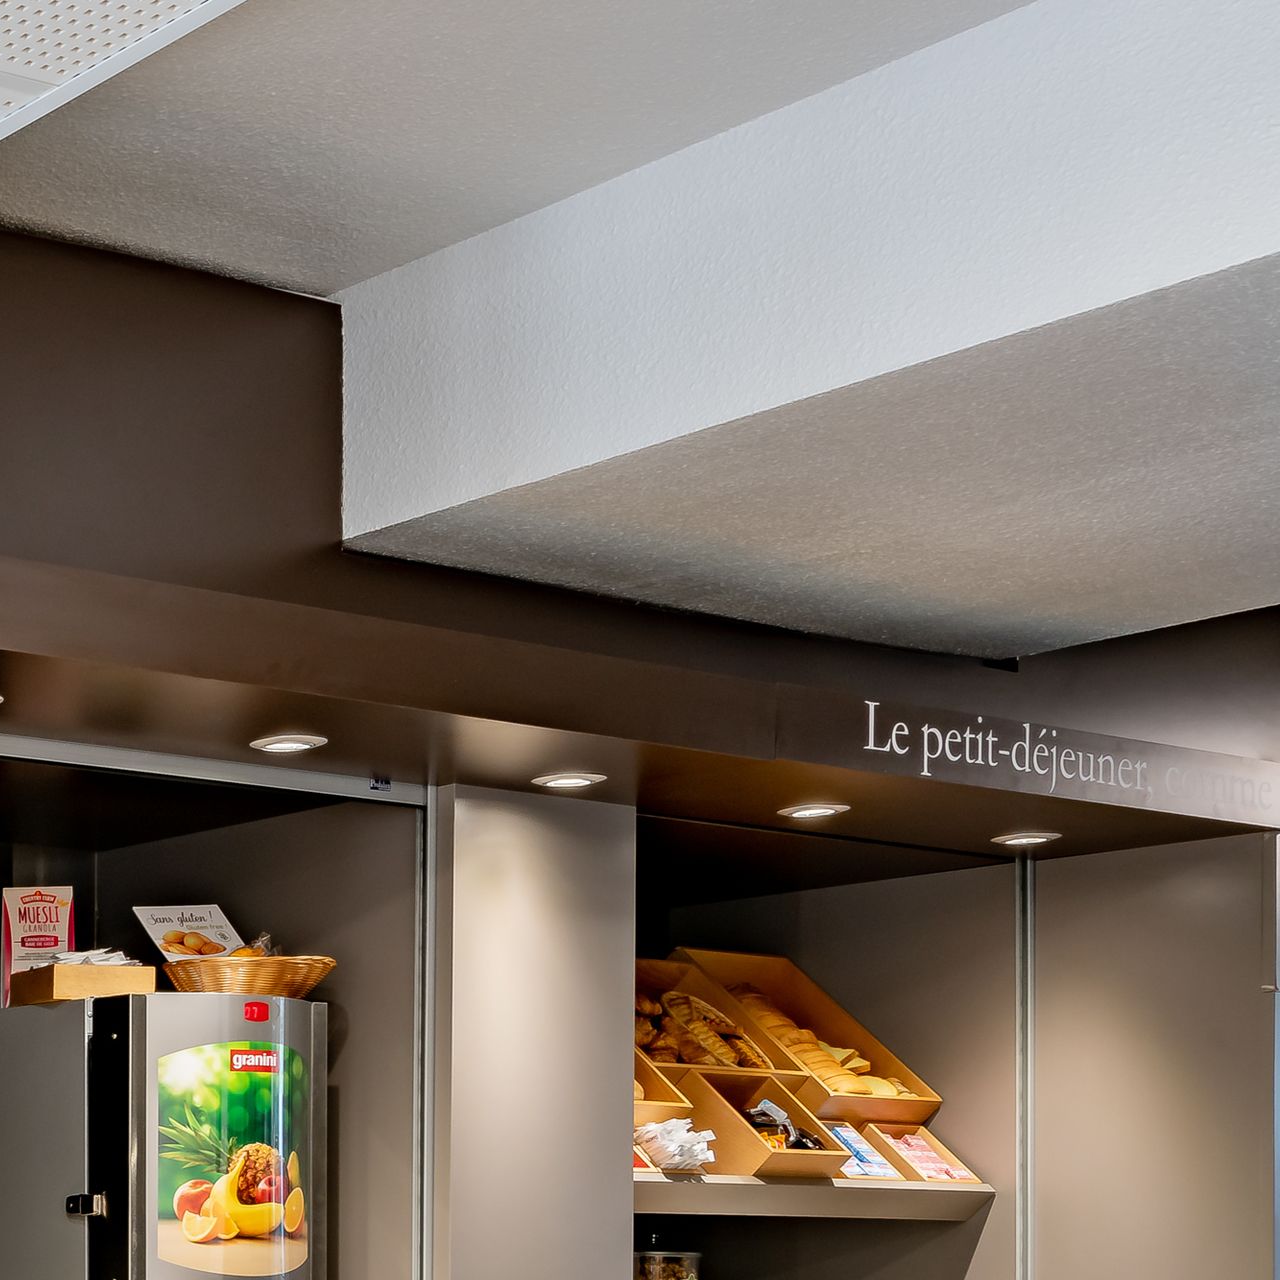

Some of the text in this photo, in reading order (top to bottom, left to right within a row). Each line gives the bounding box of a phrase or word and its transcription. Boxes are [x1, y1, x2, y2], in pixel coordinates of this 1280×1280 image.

[863, 699, 911, 755] Le
[920, 715, 1154, 794] petit-déjeuner,
[18, 906, 61, 924] MUESLI
[147, 914, 174, 926] Sans
[177, 911, 208, 927] gluten
[22, 924, 57, 933] GRANOLA
[232, 1052, 277, 1069] granini
